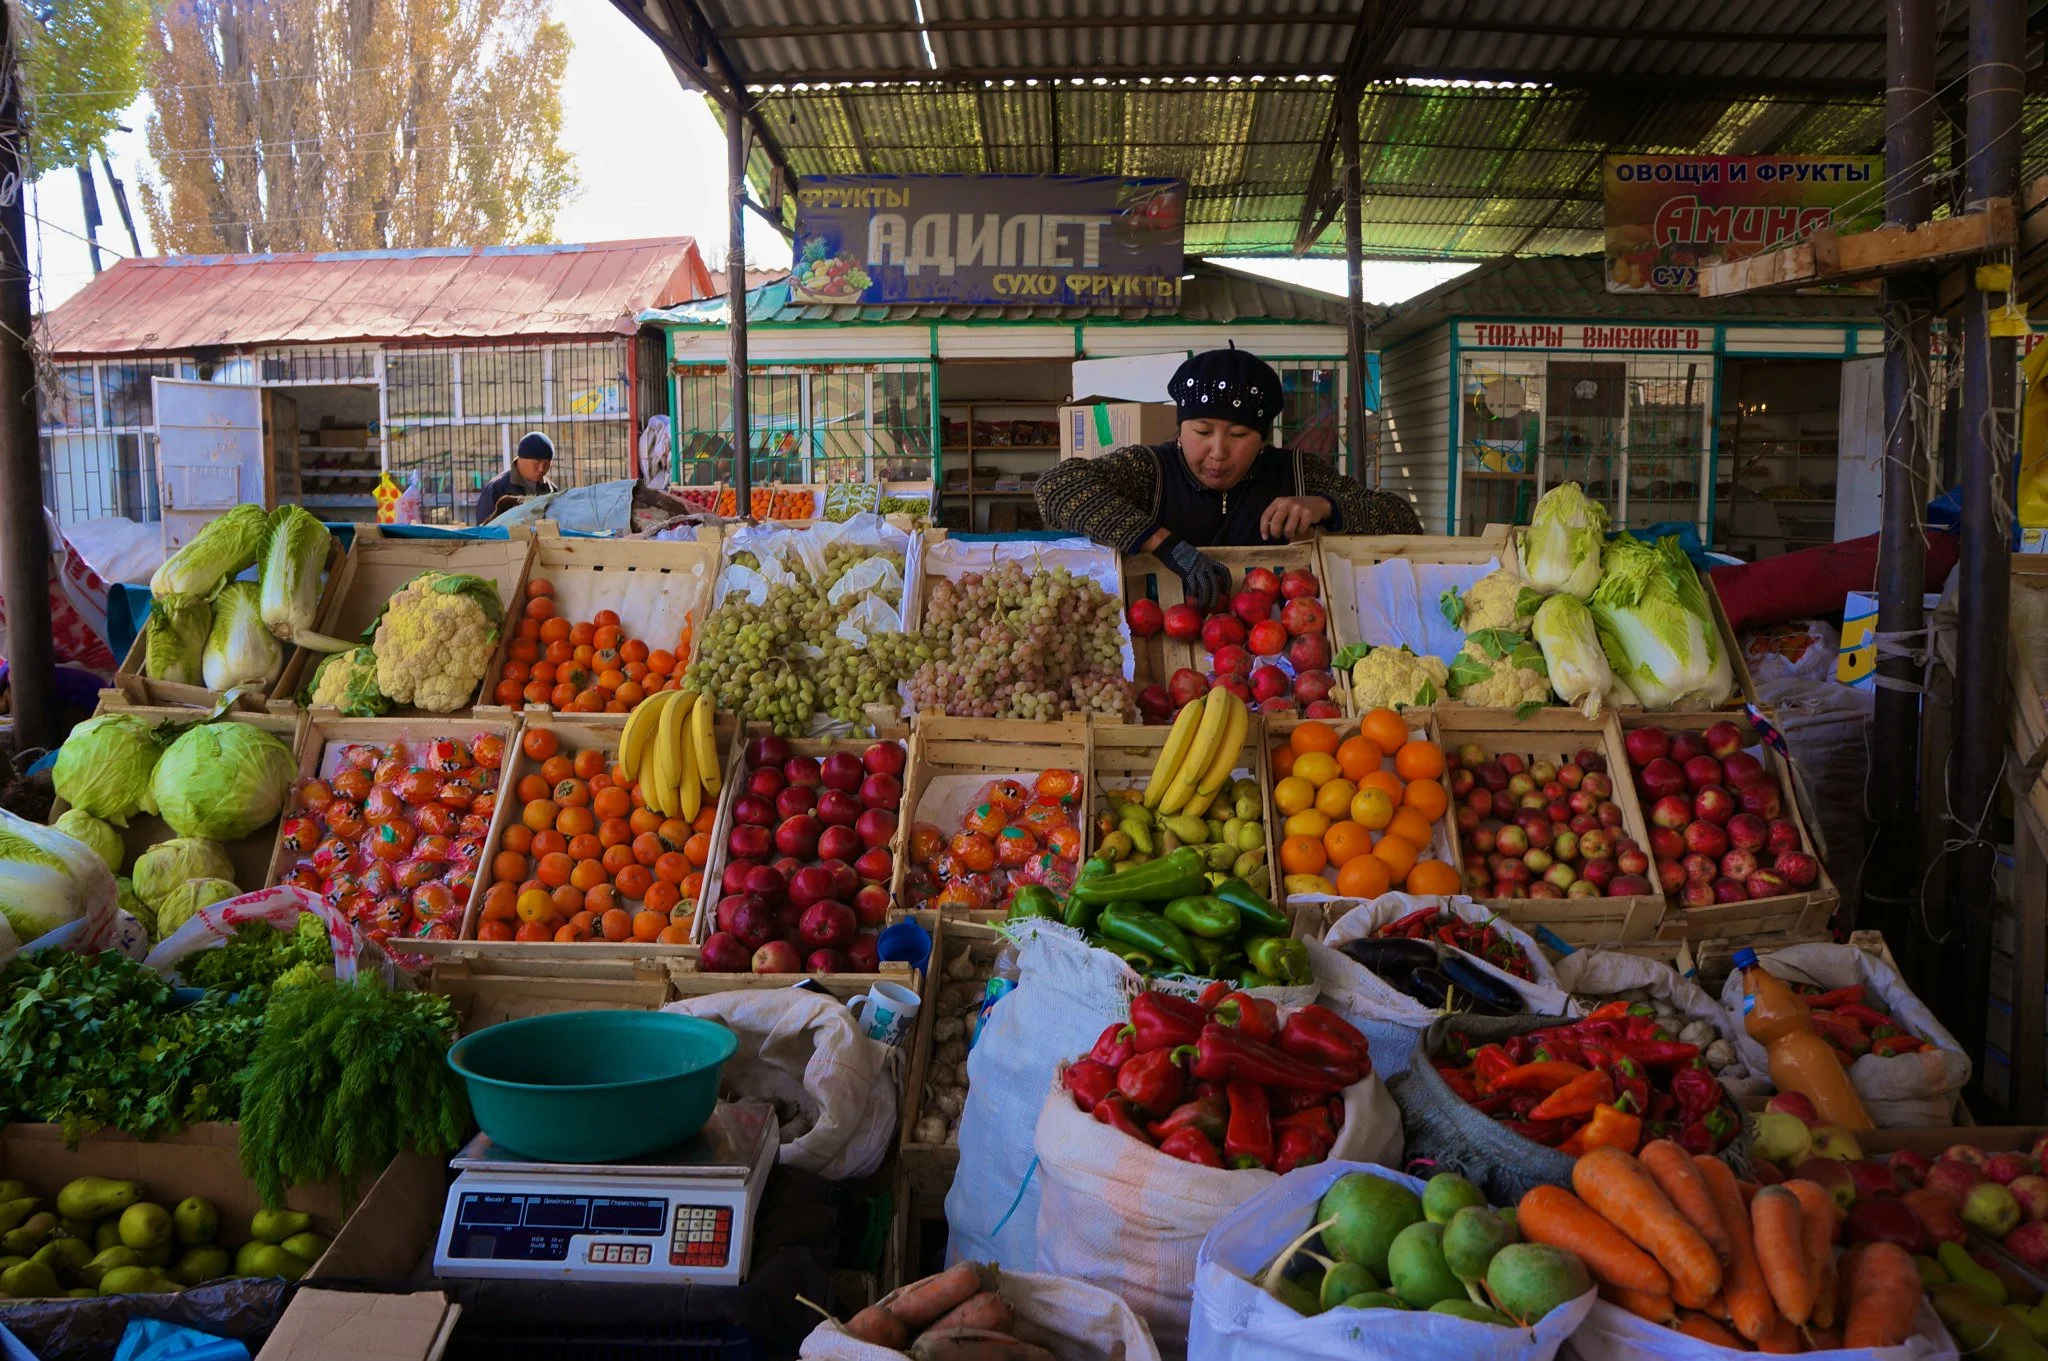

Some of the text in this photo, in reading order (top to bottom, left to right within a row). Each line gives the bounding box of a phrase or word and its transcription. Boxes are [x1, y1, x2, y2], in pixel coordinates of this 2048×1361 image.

[1616, 162, 1870, 184] ОВОЩИ И ФРУКТЫ
[799, 186, 910, 208] ФРУКТЫ
[868, 213, 1112, 276] АДИЛЕТ
[993, 273, 1182, 297] СУХО ФРУКТЫ
[1474, 324, 1699, 350] ТОВАРЫ ВЫСОКОГО
